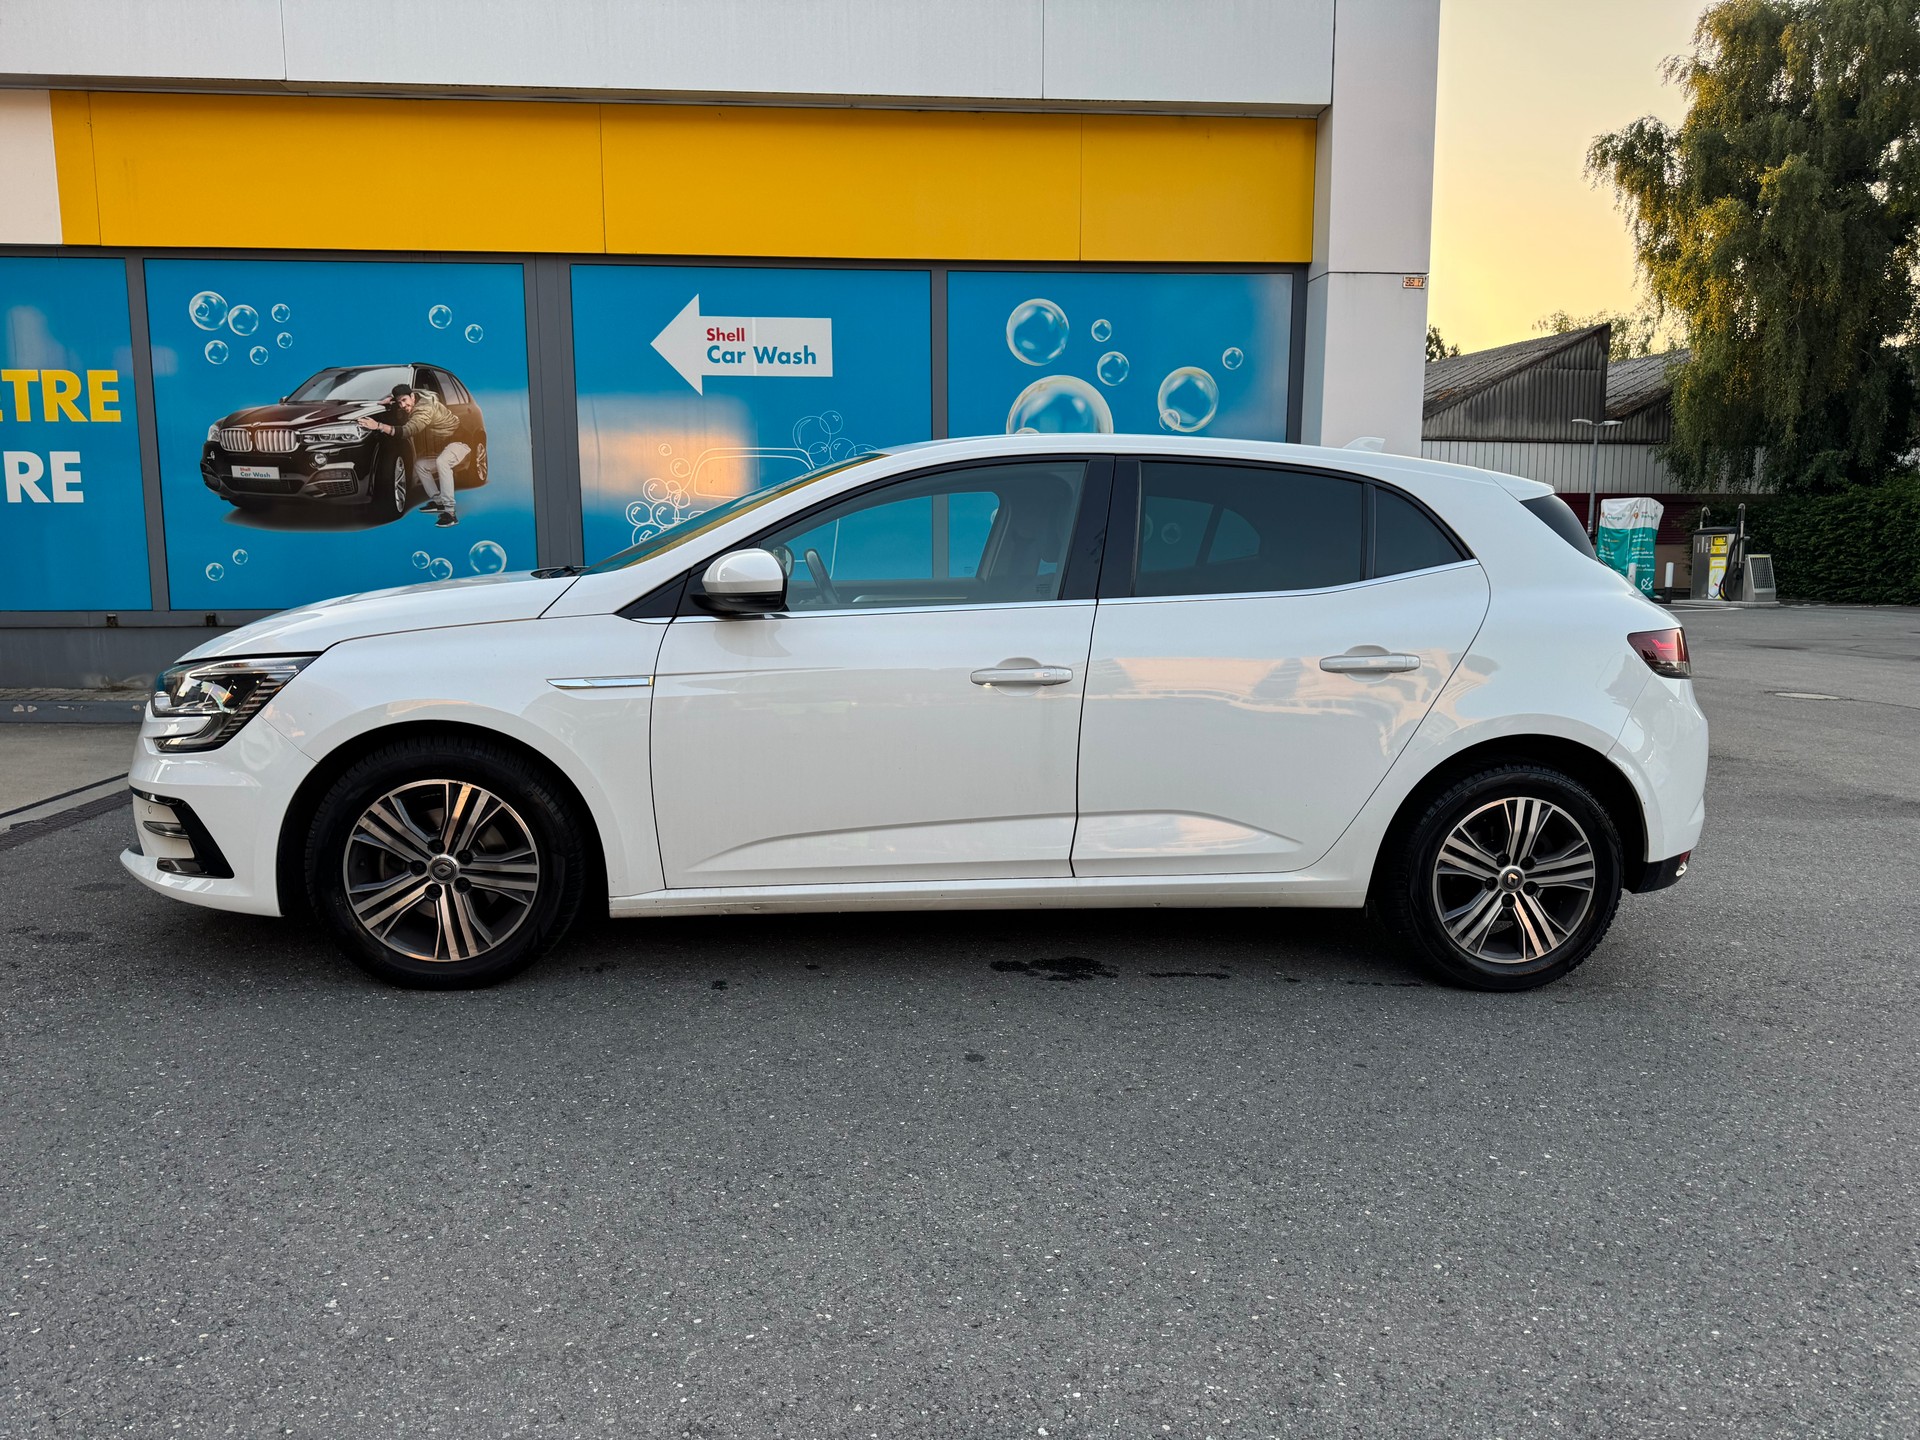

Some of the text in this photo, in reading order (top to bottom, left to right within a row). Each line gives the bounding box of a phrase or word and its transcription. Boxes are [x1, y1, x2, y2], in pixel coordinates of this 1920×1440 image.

[706, 327, 746, 342] Shell
[706, 344, 817, 365] Car Wash
[0, 369, 122, 422] TRE
